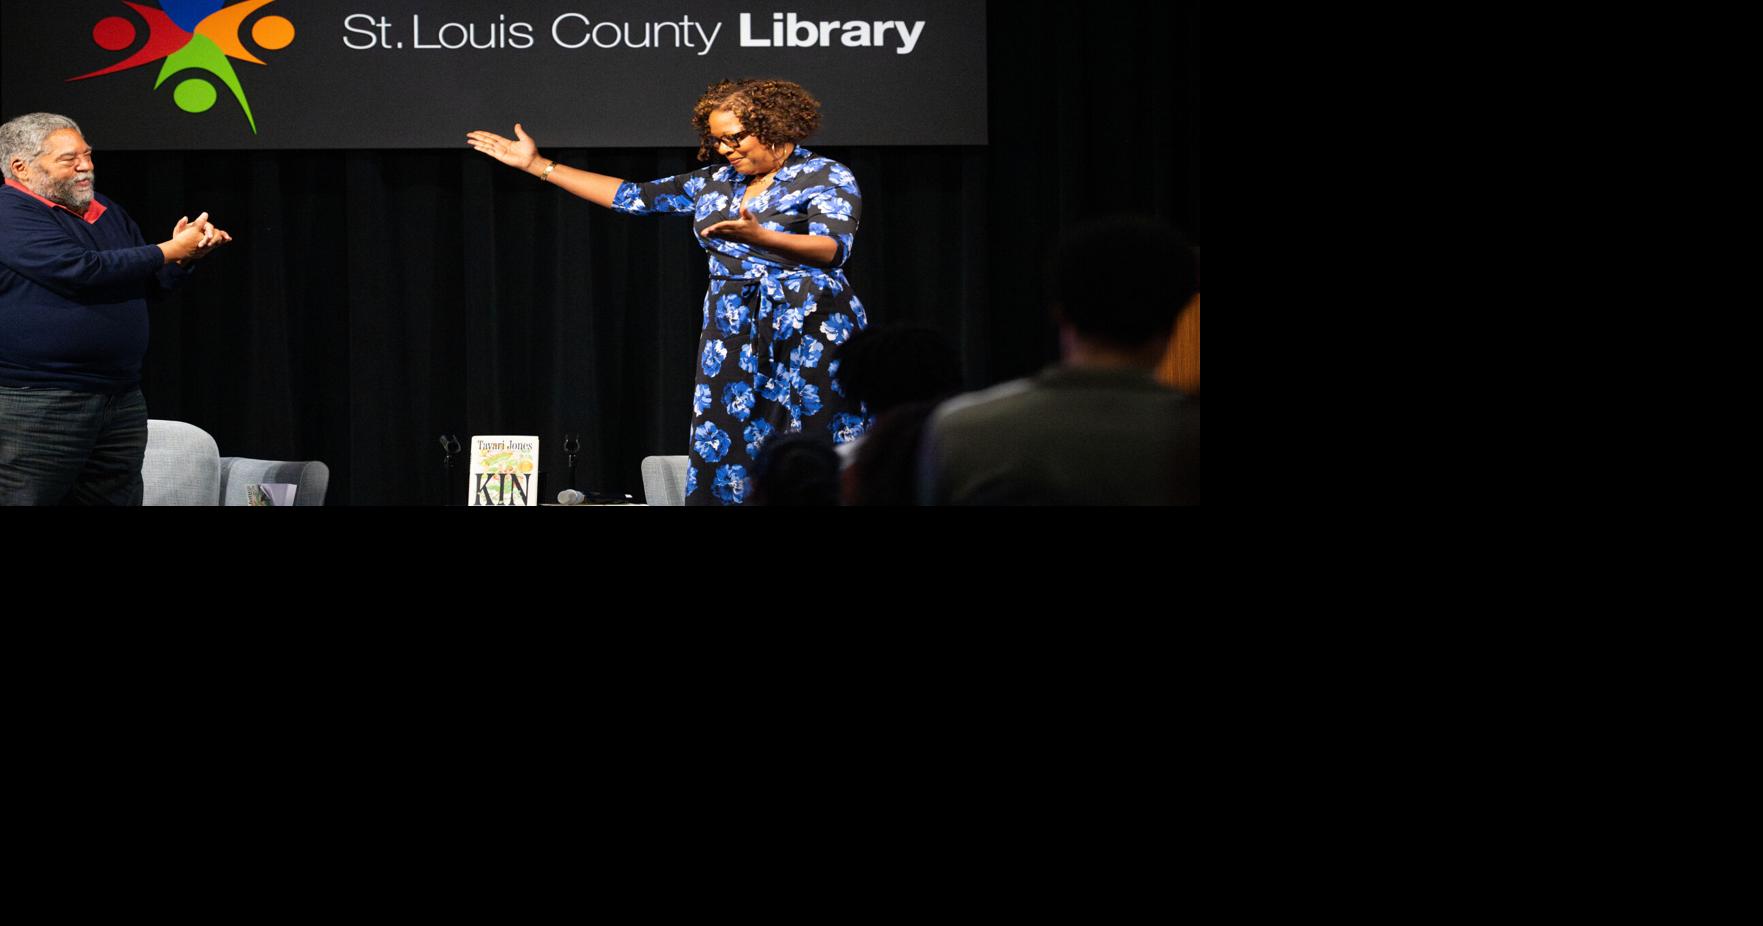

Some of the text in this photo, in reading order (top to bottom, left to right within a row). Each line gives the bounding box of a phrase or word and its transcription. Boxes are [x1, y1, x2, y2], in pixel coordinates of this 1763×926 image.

[342, 12, 926, 56] St. Louis County Library
[478, 440, 533, 452] Tayari Jones
[473, 473, 532, 506] KIN
